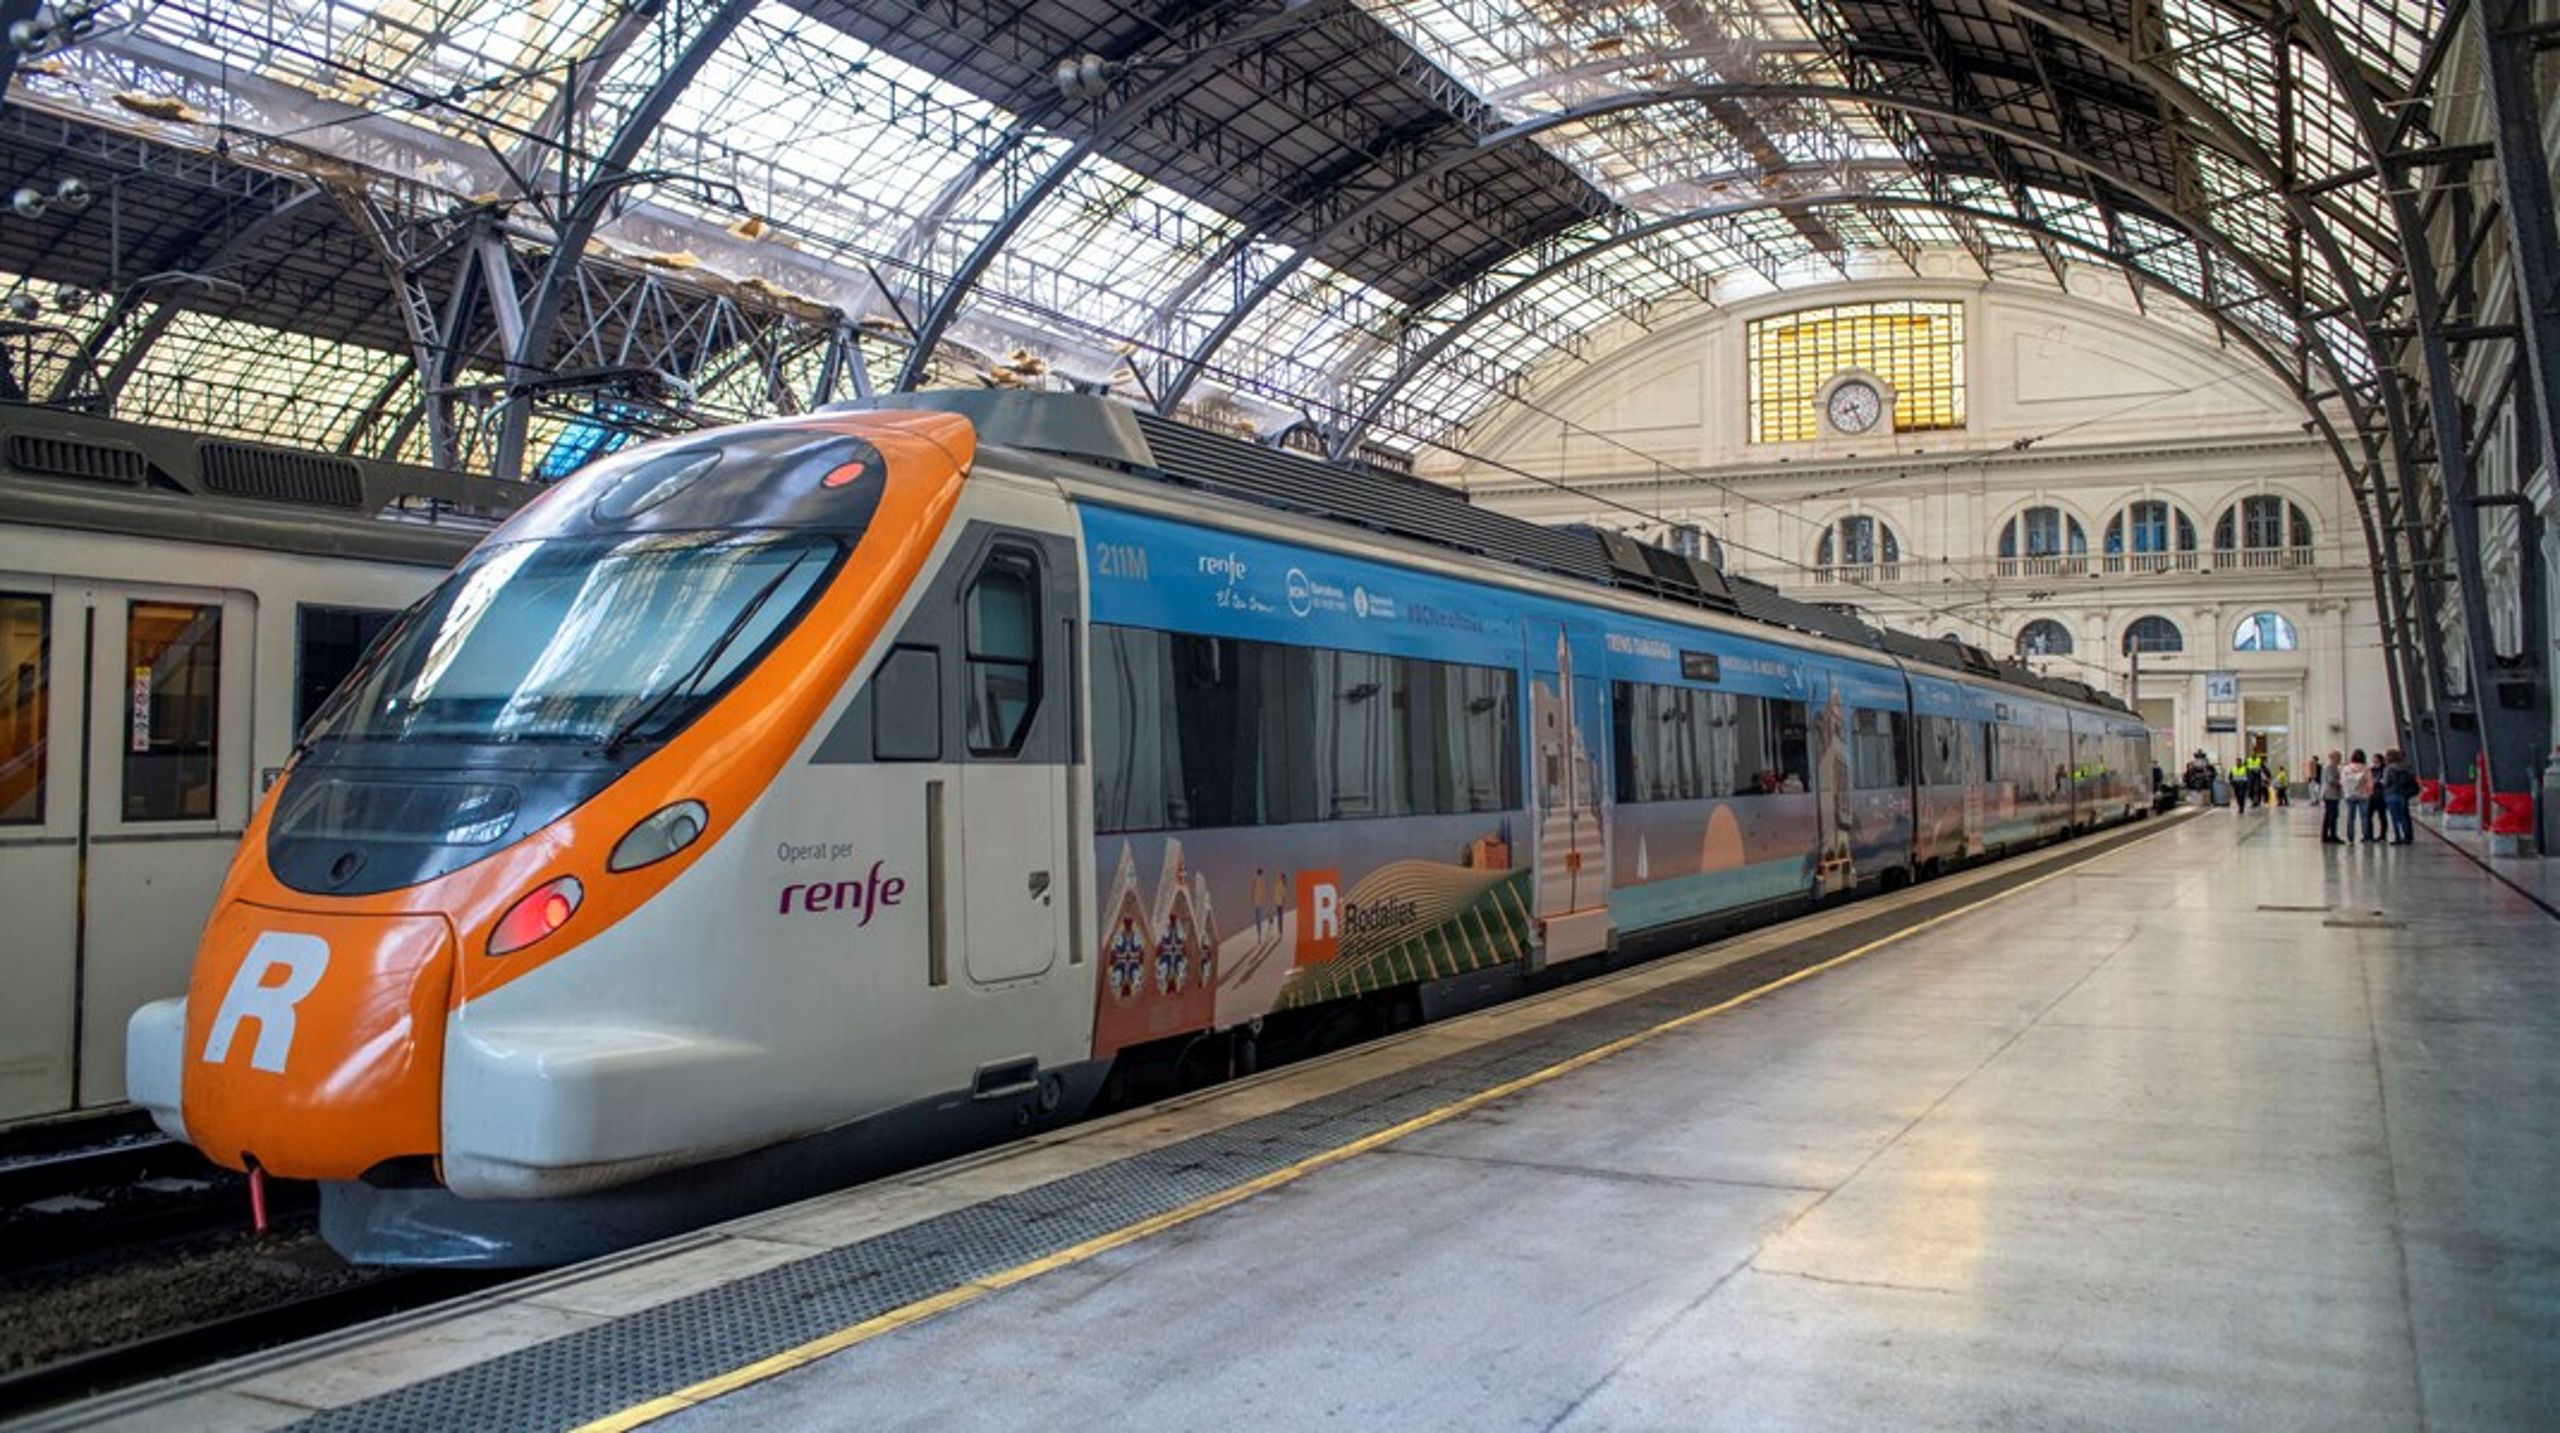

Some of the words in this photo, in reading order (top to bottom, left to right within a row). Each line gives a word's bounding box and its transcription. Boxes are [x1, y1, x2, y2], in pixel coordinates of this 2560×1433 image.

[1096, 542, 1149, 582] 211M
[1198, 552, 1247, 585] renfe
[2208, 680, 2232, 697] 14
[778, 841, 828, 865] Operat
[831, 843, 854, 861] per
[779, 859, 906, 928] renfe
[1312, 882, 1338, 941] R
[1344, 895, 1417, 933] Rodalies
[202, 930, 332, 1074] R
